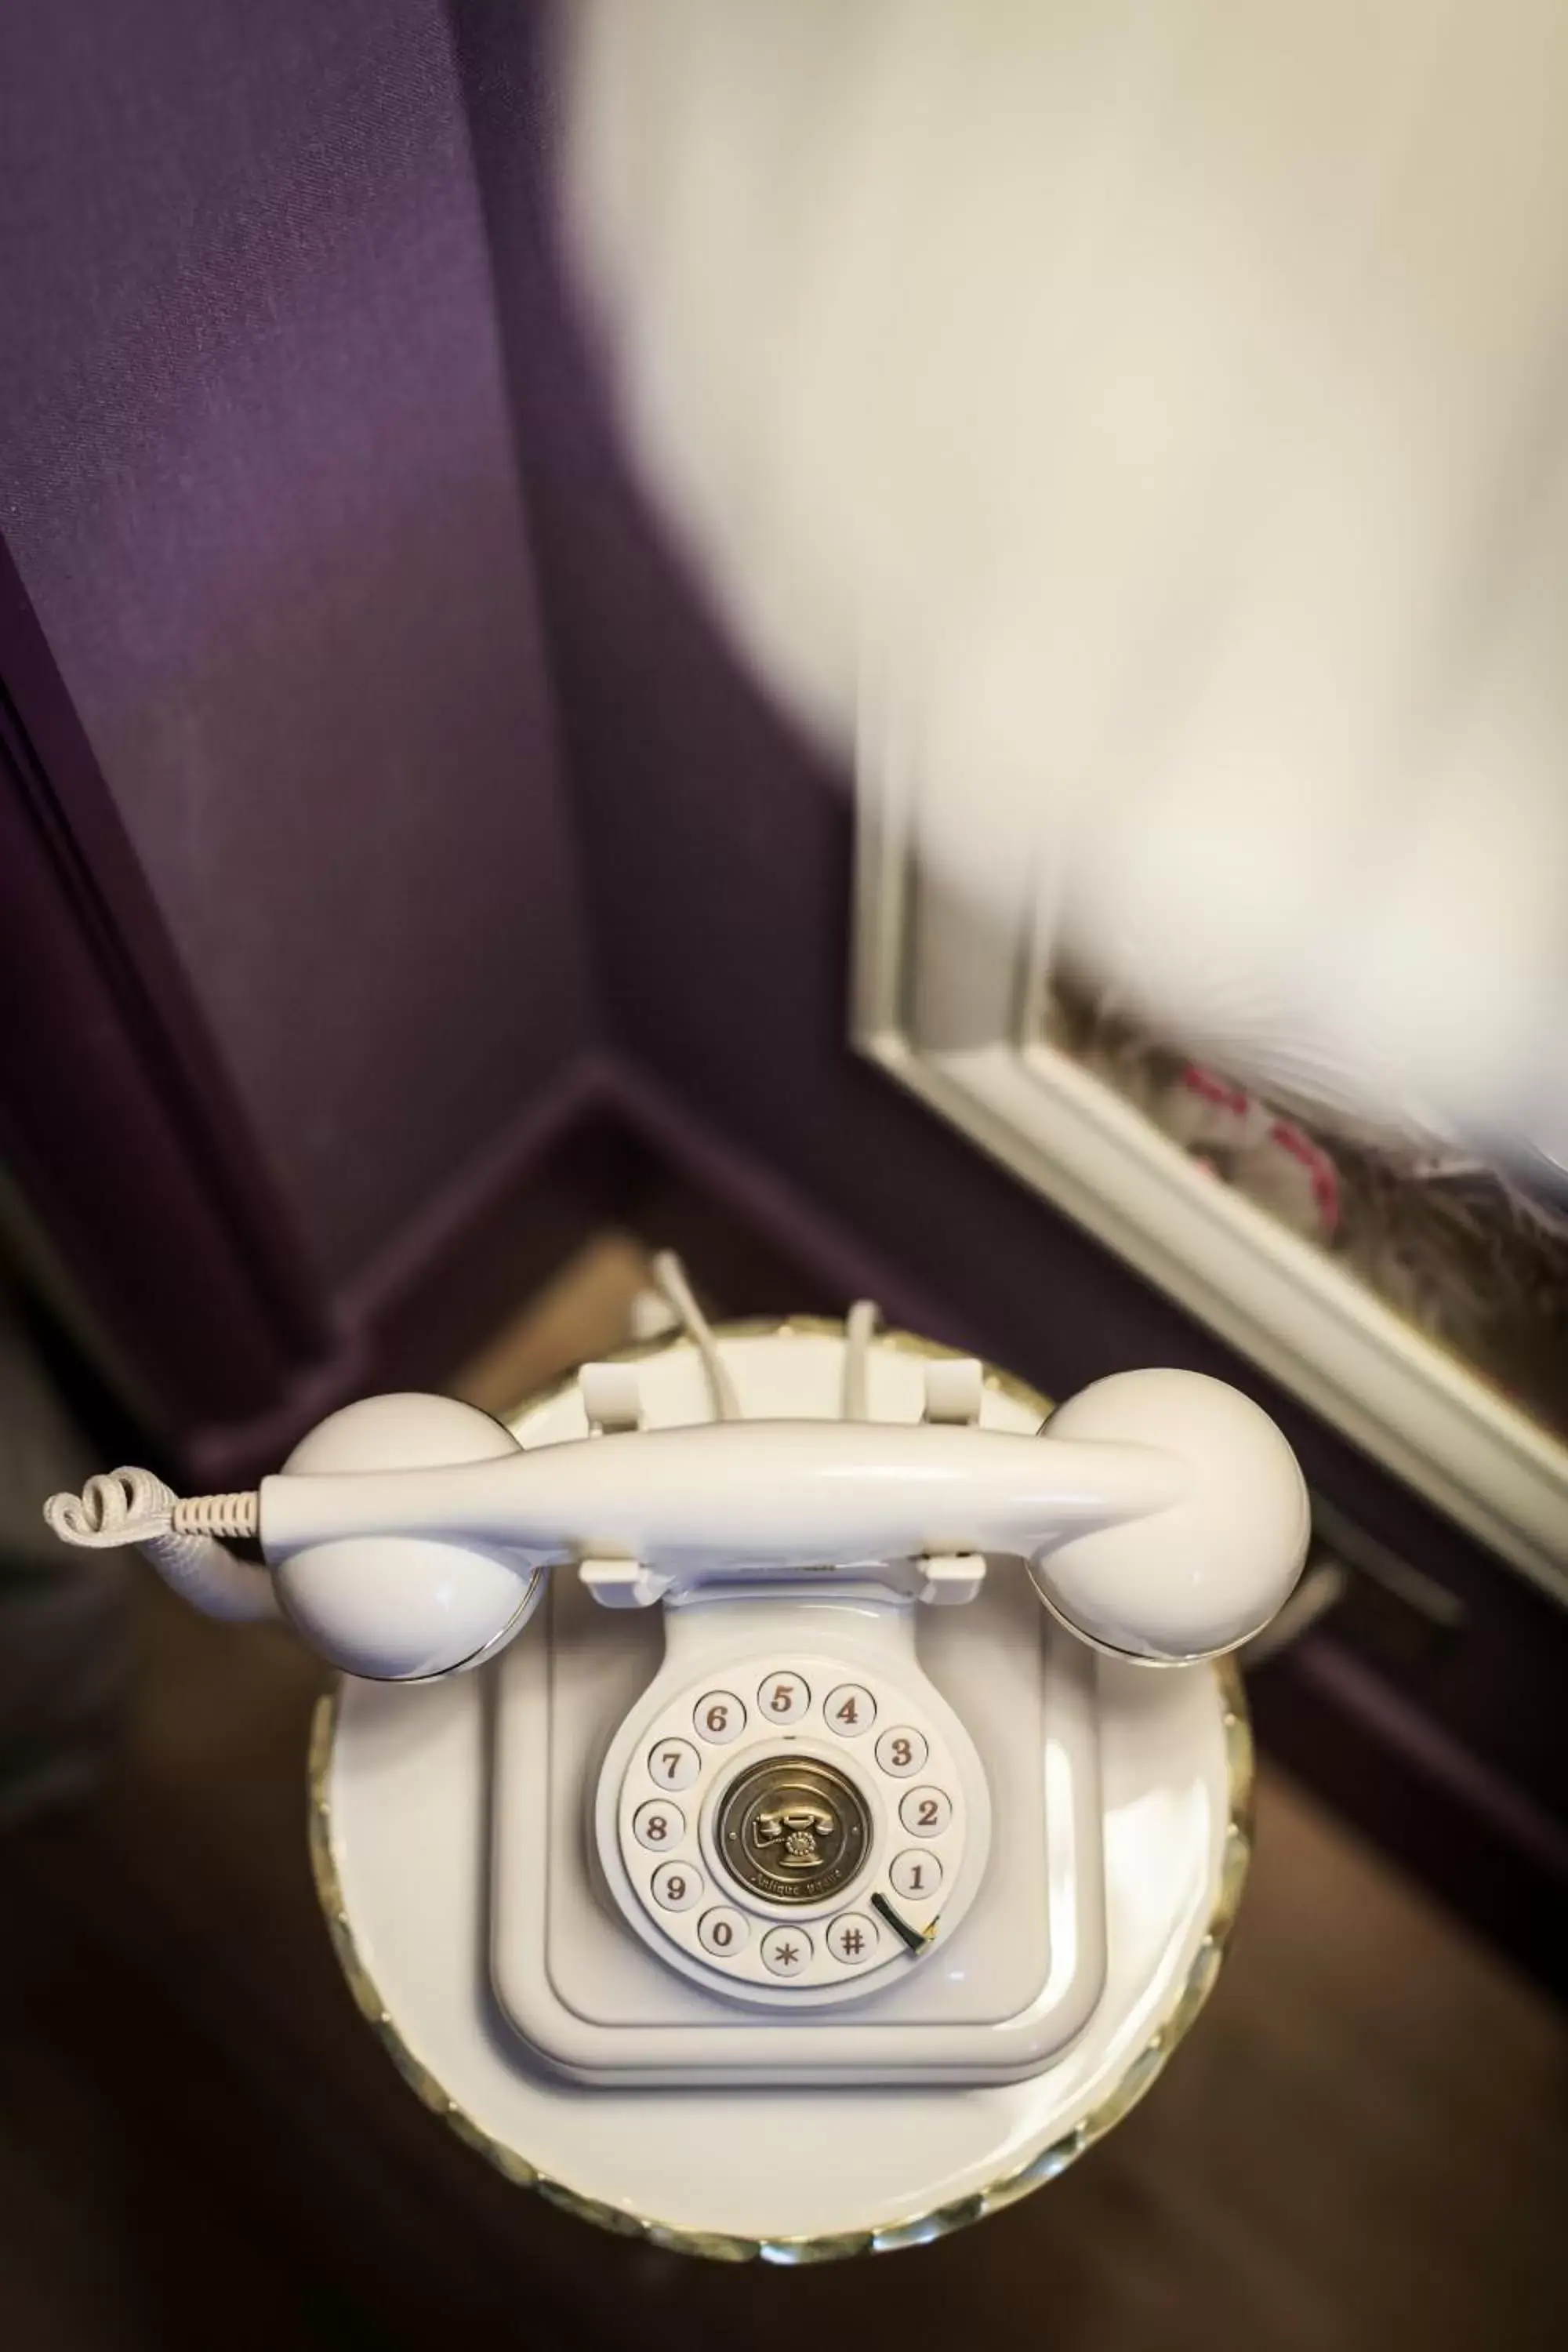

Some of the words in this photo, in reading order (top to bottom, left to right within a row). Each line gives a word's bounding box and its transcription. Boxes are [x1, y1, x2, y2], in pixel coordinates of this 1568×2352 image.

[771, 1686, 793, 1712] 5
[837, 1697, 858, 1724] 4
[707, 1706, 728, 1731] 6
[892, 1739, 912, 1766] 3
[662, 1754, 681, 1778] 7
[918, 1800, 938, 1825] 2
[647, 1817, 666, 1841] 8
[667, 1876, 685, 1900] 9
[909, 1865, 924, 1889] 1
[713, 1922, 732, 1947] 0
[840, 1929, 864, 1955] #
